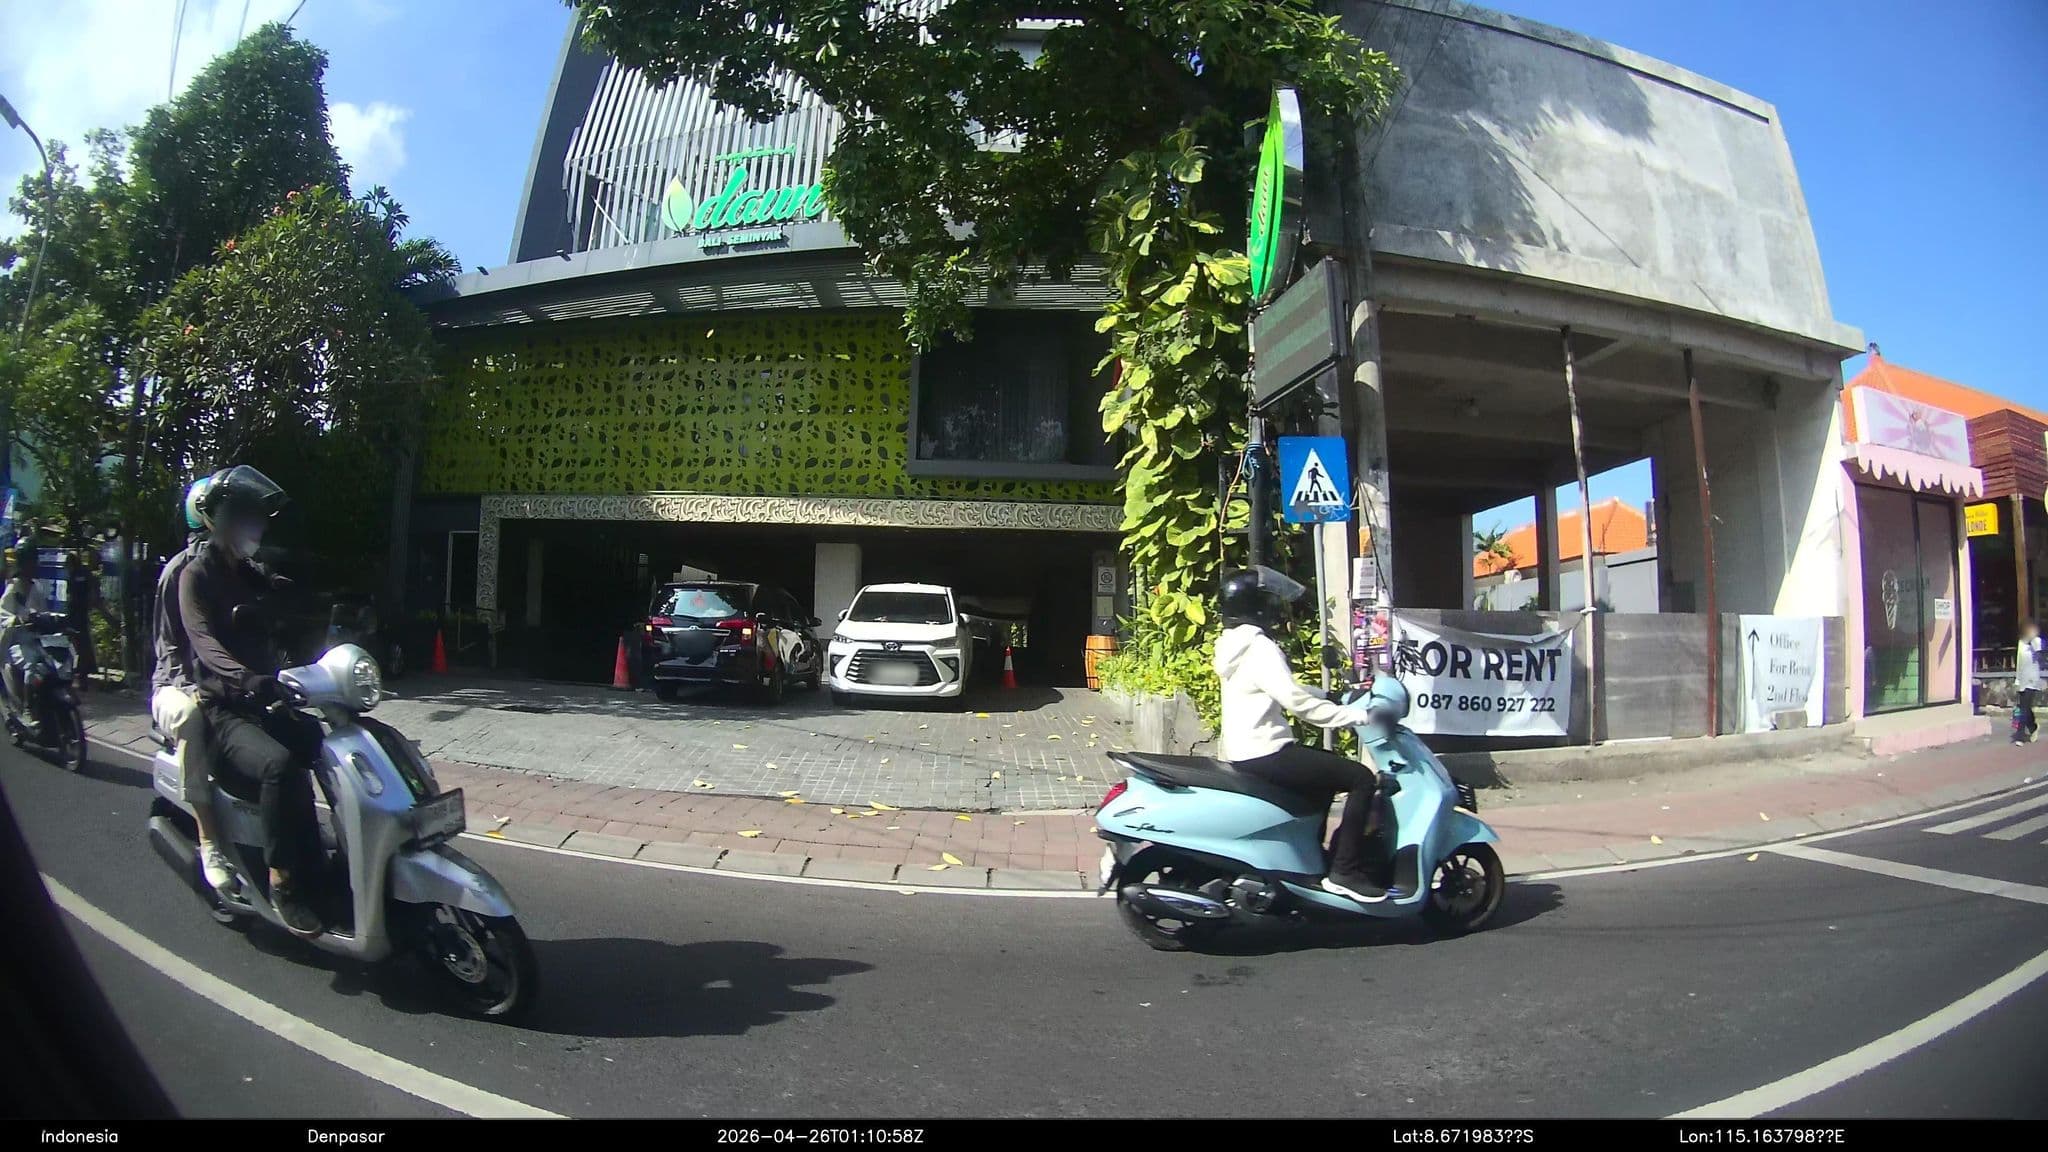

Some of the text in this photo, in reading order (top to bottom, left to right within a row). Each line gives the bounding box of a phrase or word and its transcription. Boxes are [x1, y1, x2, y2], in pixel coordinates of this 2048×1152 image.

[693, 166, 826, 229] daun
[1769, 632, 1800, 648] Office
[1483, 647, 1562, 682] RENT
[1769, 658, 1787, 674] For
[1767, 685, 1787, 702] 2nd
[1417, 693, 1556, 713] 087 860 927 222
